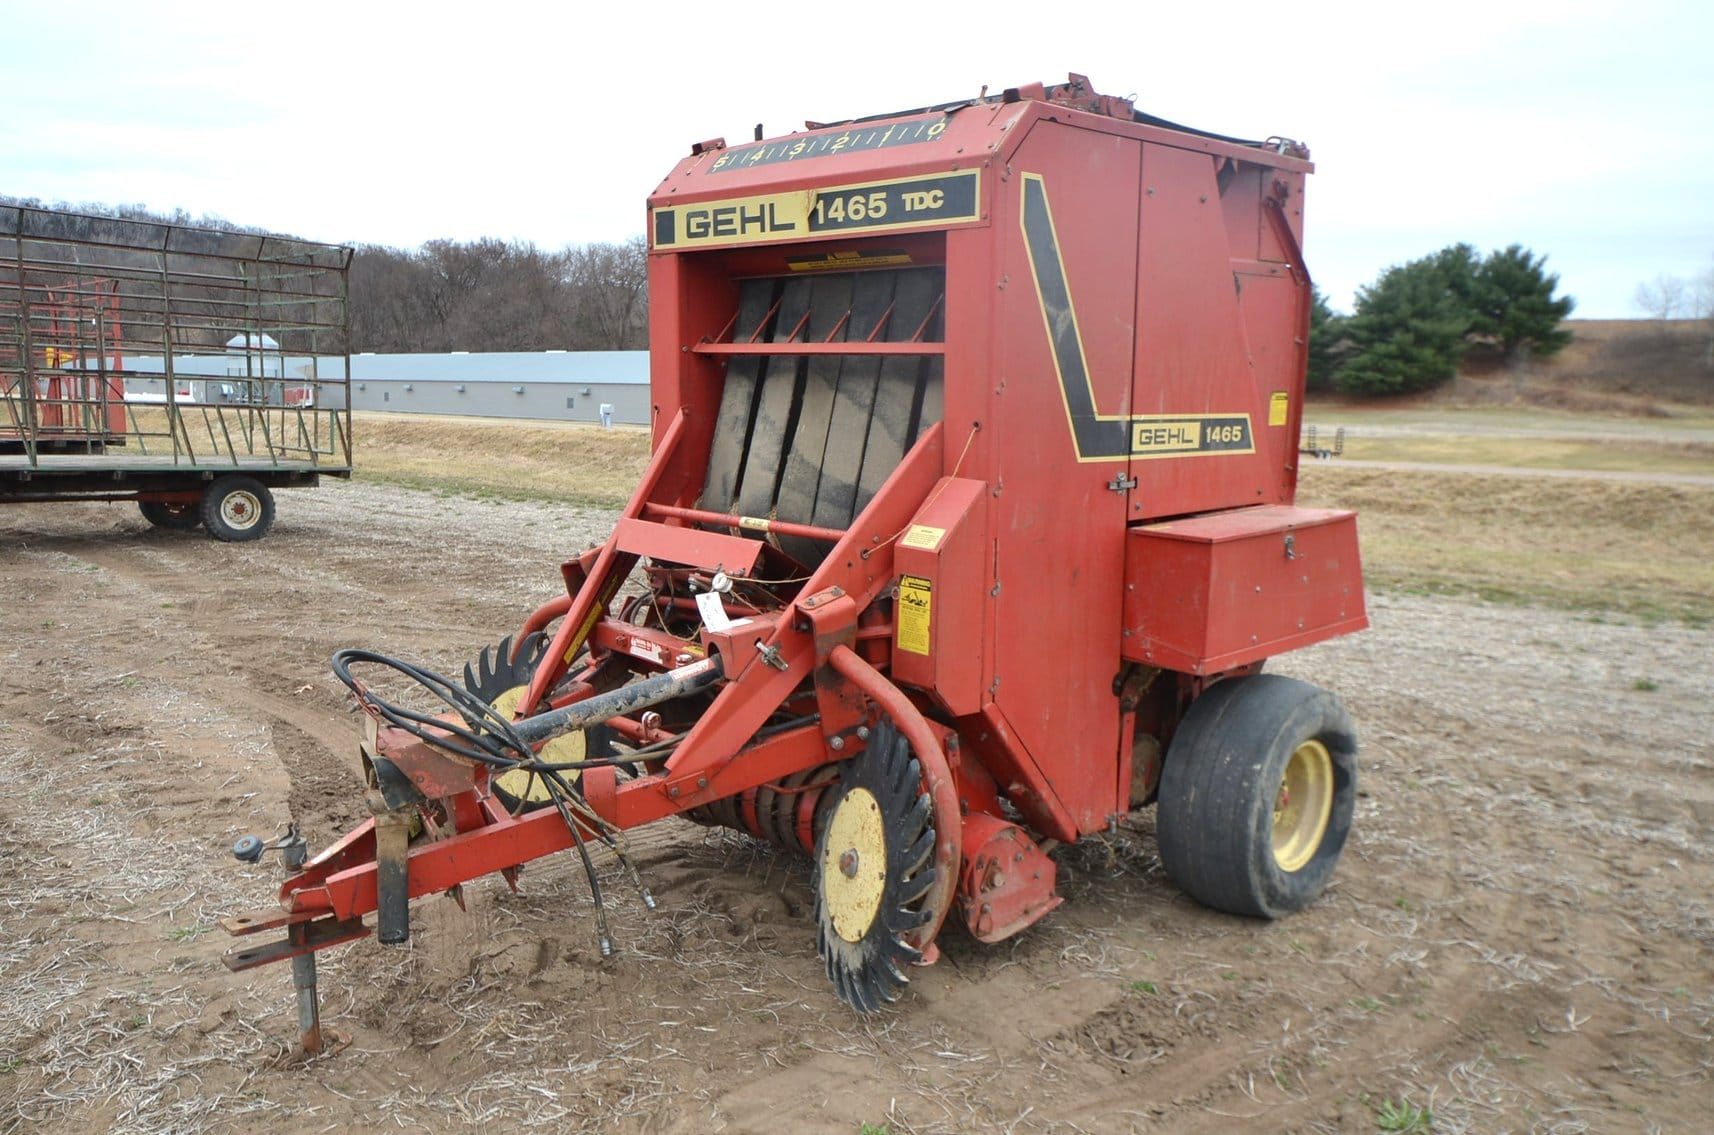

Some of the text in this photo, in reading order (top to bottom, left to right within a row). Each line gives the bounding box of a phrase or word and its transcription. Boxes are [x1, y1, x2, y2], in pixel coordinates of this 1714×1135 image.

[713, 156, 729, 168] 5
[750, 149, 765, 161] 4
[789, 143, 806, 155] 3
[831, 136, 850, 150] 2
[927, 122, 945, 135] 0
[685, 189, 944, 239] GEHL 1465 TDC
[1139, 426, 1242, 445] GEHL 1465
